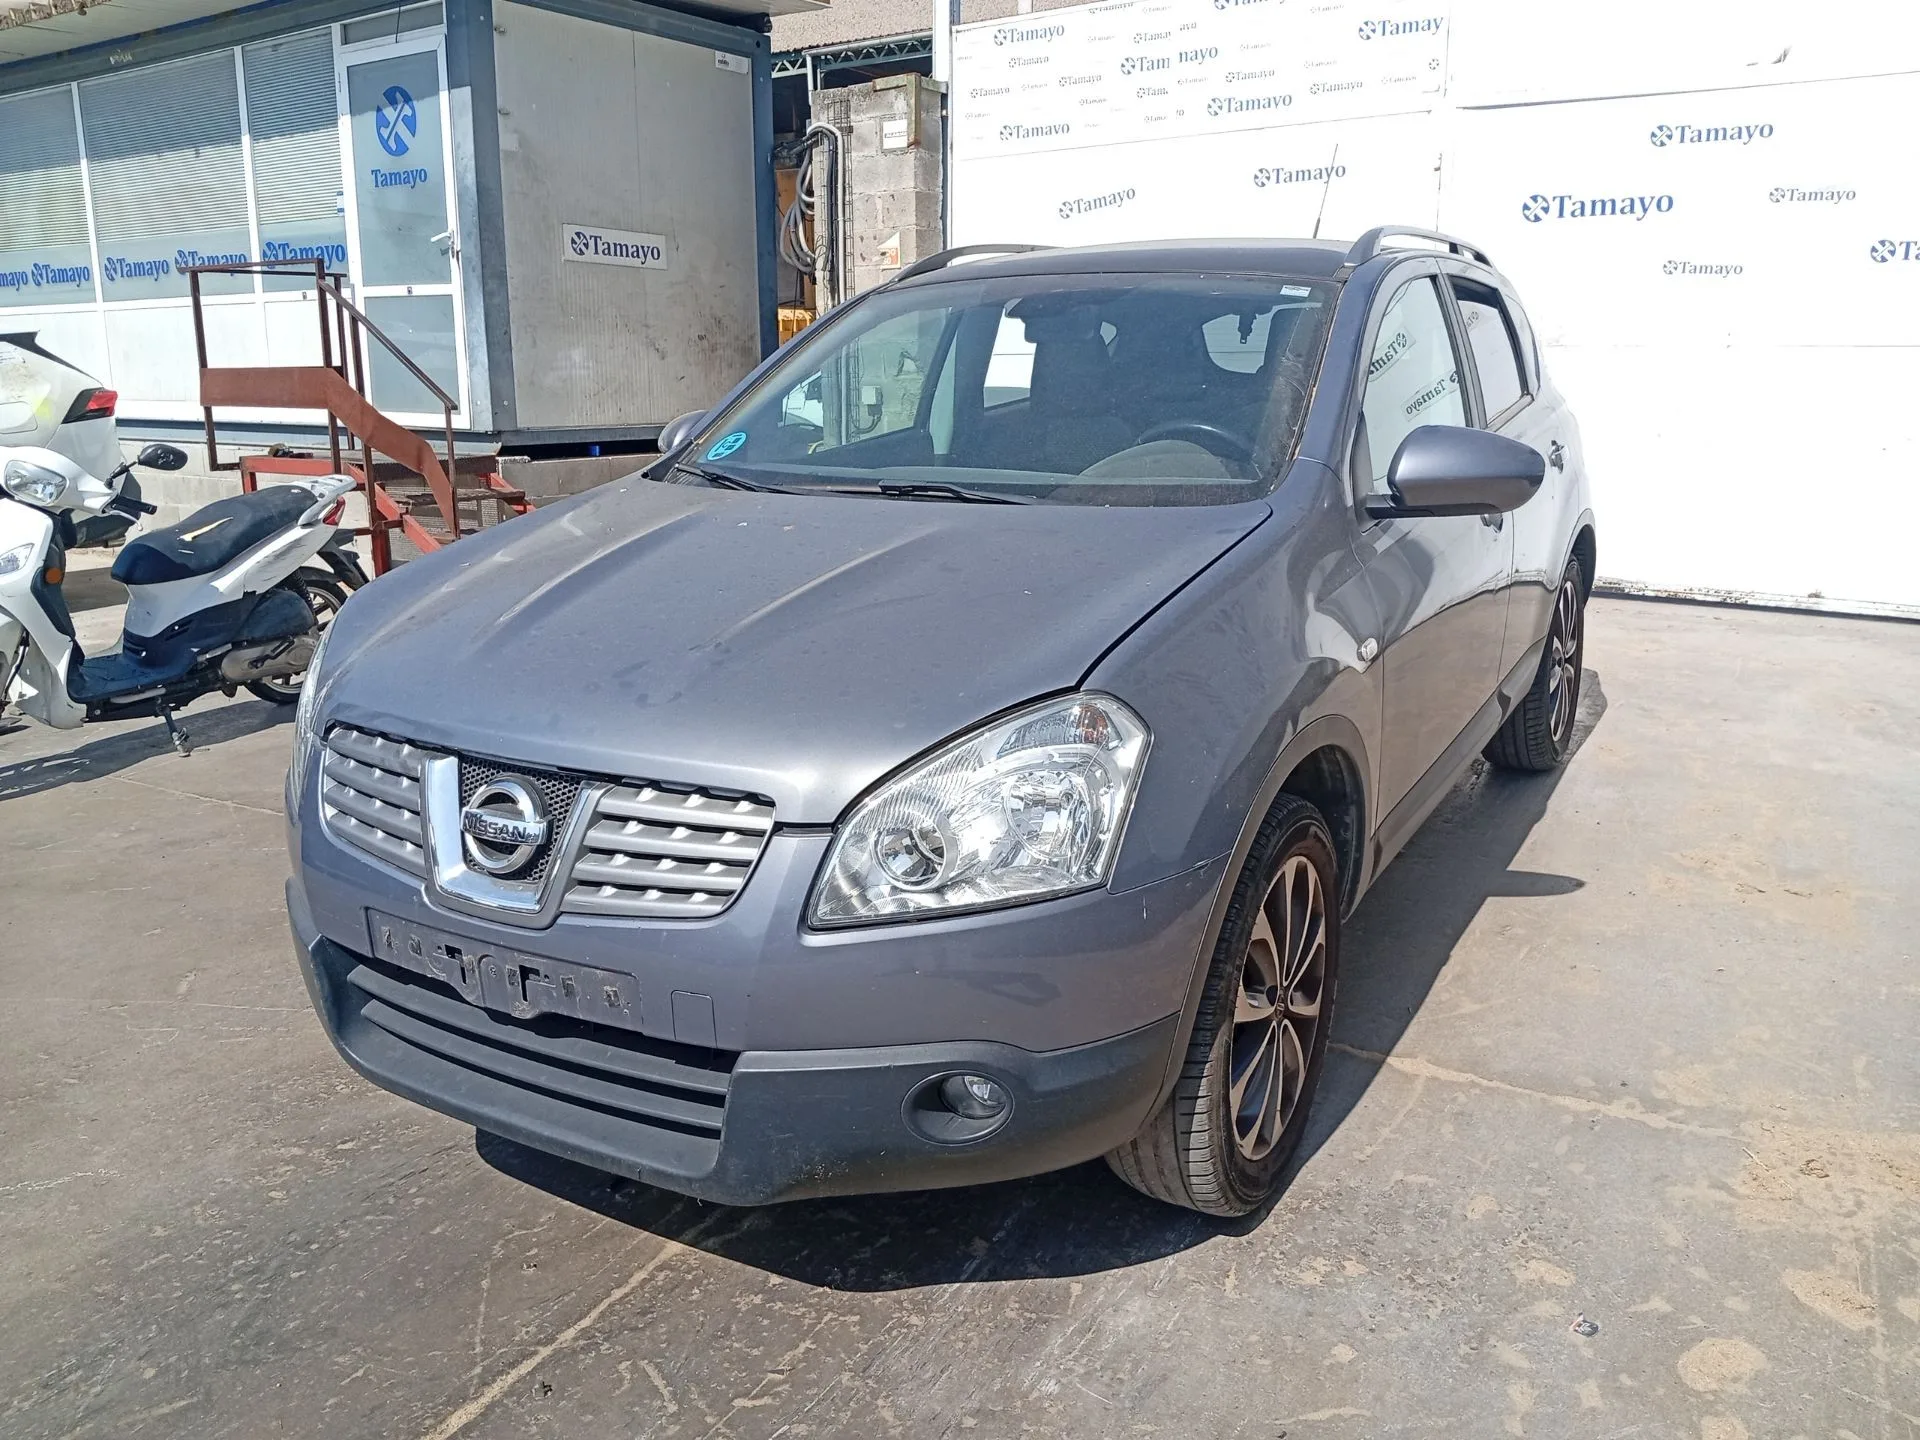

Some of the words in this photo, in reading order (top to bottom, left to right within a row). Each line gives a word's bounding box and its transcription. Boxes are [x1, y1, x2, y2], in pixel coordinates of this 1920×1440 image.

[1008, 24, 1065, 43] Tamayo
[1224, 94, 1293, 113] Tamayo
[1013, 123, 1071, 139] Tamayo
[1675, 122, 1774, 147] Tamayo
[371, 168, 428, 190] Tamayo
[1271, 164, 1347, 185] Tamayo
[1073, 186, 1137, 215] Tamayo
[1552, 192, 1675, 221] Tamayo
[1786, 187, 1857, 205] Tamayo
[278, 242, 346, 270] Tamayo
[589, 234, 661, 265] Tamayo
[42, 264, 90, 288] Tamayo
[116, 257, 169, 281] Tamayo
[1678, 260, 1744, 278] Tamayo
[465, 815, 527, 840] NISSAN
